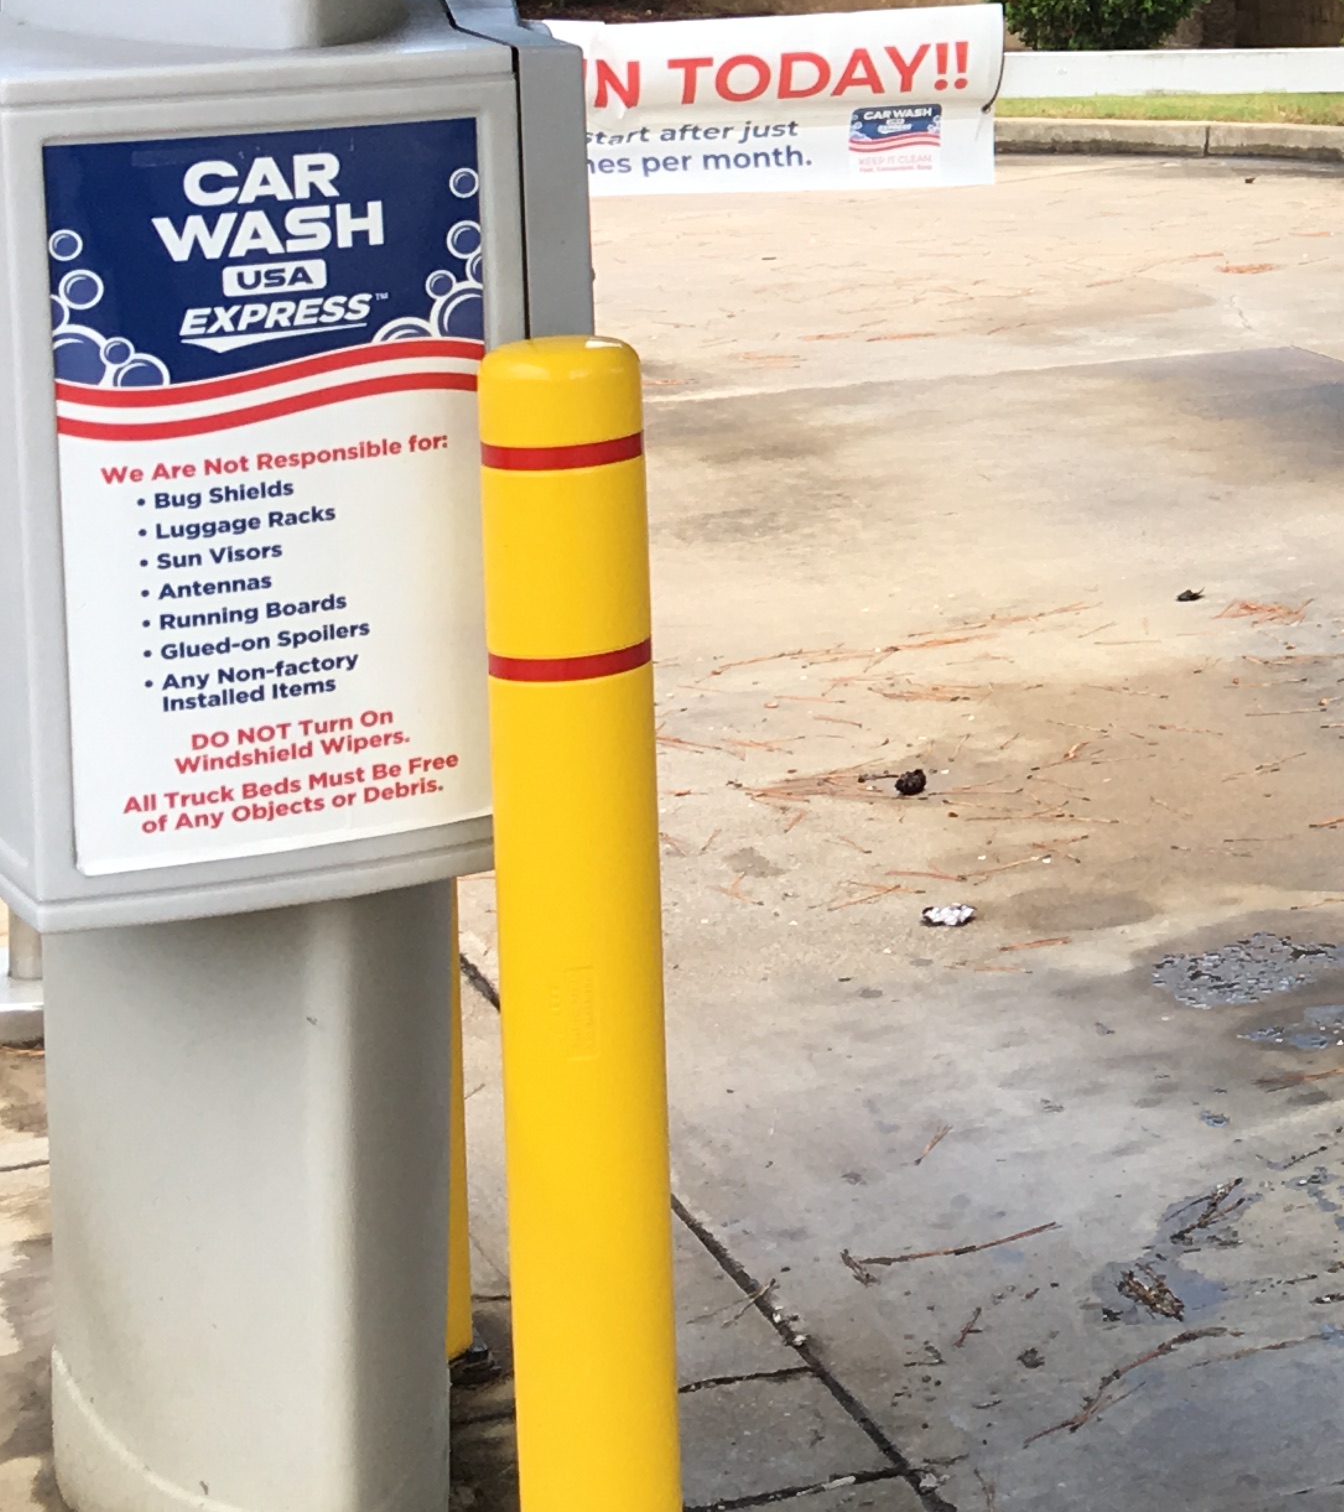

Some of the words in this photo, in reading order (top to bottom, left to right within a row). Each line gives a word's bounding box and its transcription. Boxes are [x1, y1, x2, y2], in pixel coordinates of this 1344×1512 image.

[667, 40, 970, 105] TODAY!!
[659, 123, 732, 143] after
[737, 119, 800, 143] just
[863, 110, 892, 121] CAR
[892, 107, 932, 118] WASH
[641, 149, 692, 177] per
[702, 144, 813, 172] month.
[182, 152, 340, 207] CAR
[151, 200, 385, 263] WASH
[236, 266, 314, 291] USA
[179, 292, 373, 337] EXPRESS
[100, 466, 144, 485] We
[151, 463, 196, 481] Are
[204, 455, 249, 476] Not
[256, 438, 402, 471] Responsible
[408, 434, 447, 452] for:
[154, 492, 202, 509] Bug
[209, 480, 294, 504] Shields
[155, 517, 261, 540] Luggage
[268, 505, 336, 528] Racks
[157, 553, 202, 570] Sun
[209, 544, 283, 564] Visors
[158, 576, 272, 600] Antennas
[159, 606, 259, 630] Running
[266, 593, 347, 619] Boards
[160, 636, 271, 660] Glued-on
[277, 623, 370, 649] Spoilers
[161, 673, 210, 691] Any
[217, 654, 359, 685] Non-factory
[163, 684, 265, 712] Installed
[272, 679, 336, 700] Items
[191, 731, 230, 751] DO
[237, 722, 292, 745] NOT
[298, 717, 353, 736] Turn
[360, 710, 393, 727] On
[174, 740, 313, 774] Windshield
[320, 731, 410, 755] Wipers.
[123, 793, 157, 814] All
[163, 785, 235, 809] Truck
[242, 777, 302, 800] Beds
[308, 767, 365, 790] Must
[372, 763, 402, 781] Be
[408, 754, 459, 775] Free
[141, 814, 168, 834] of
[175, 811, 224, 830] Any
[231, 797, 325, 822] Objects
[331, 792, 357, 808] or
[364, 778, 443, 804] Debris.
